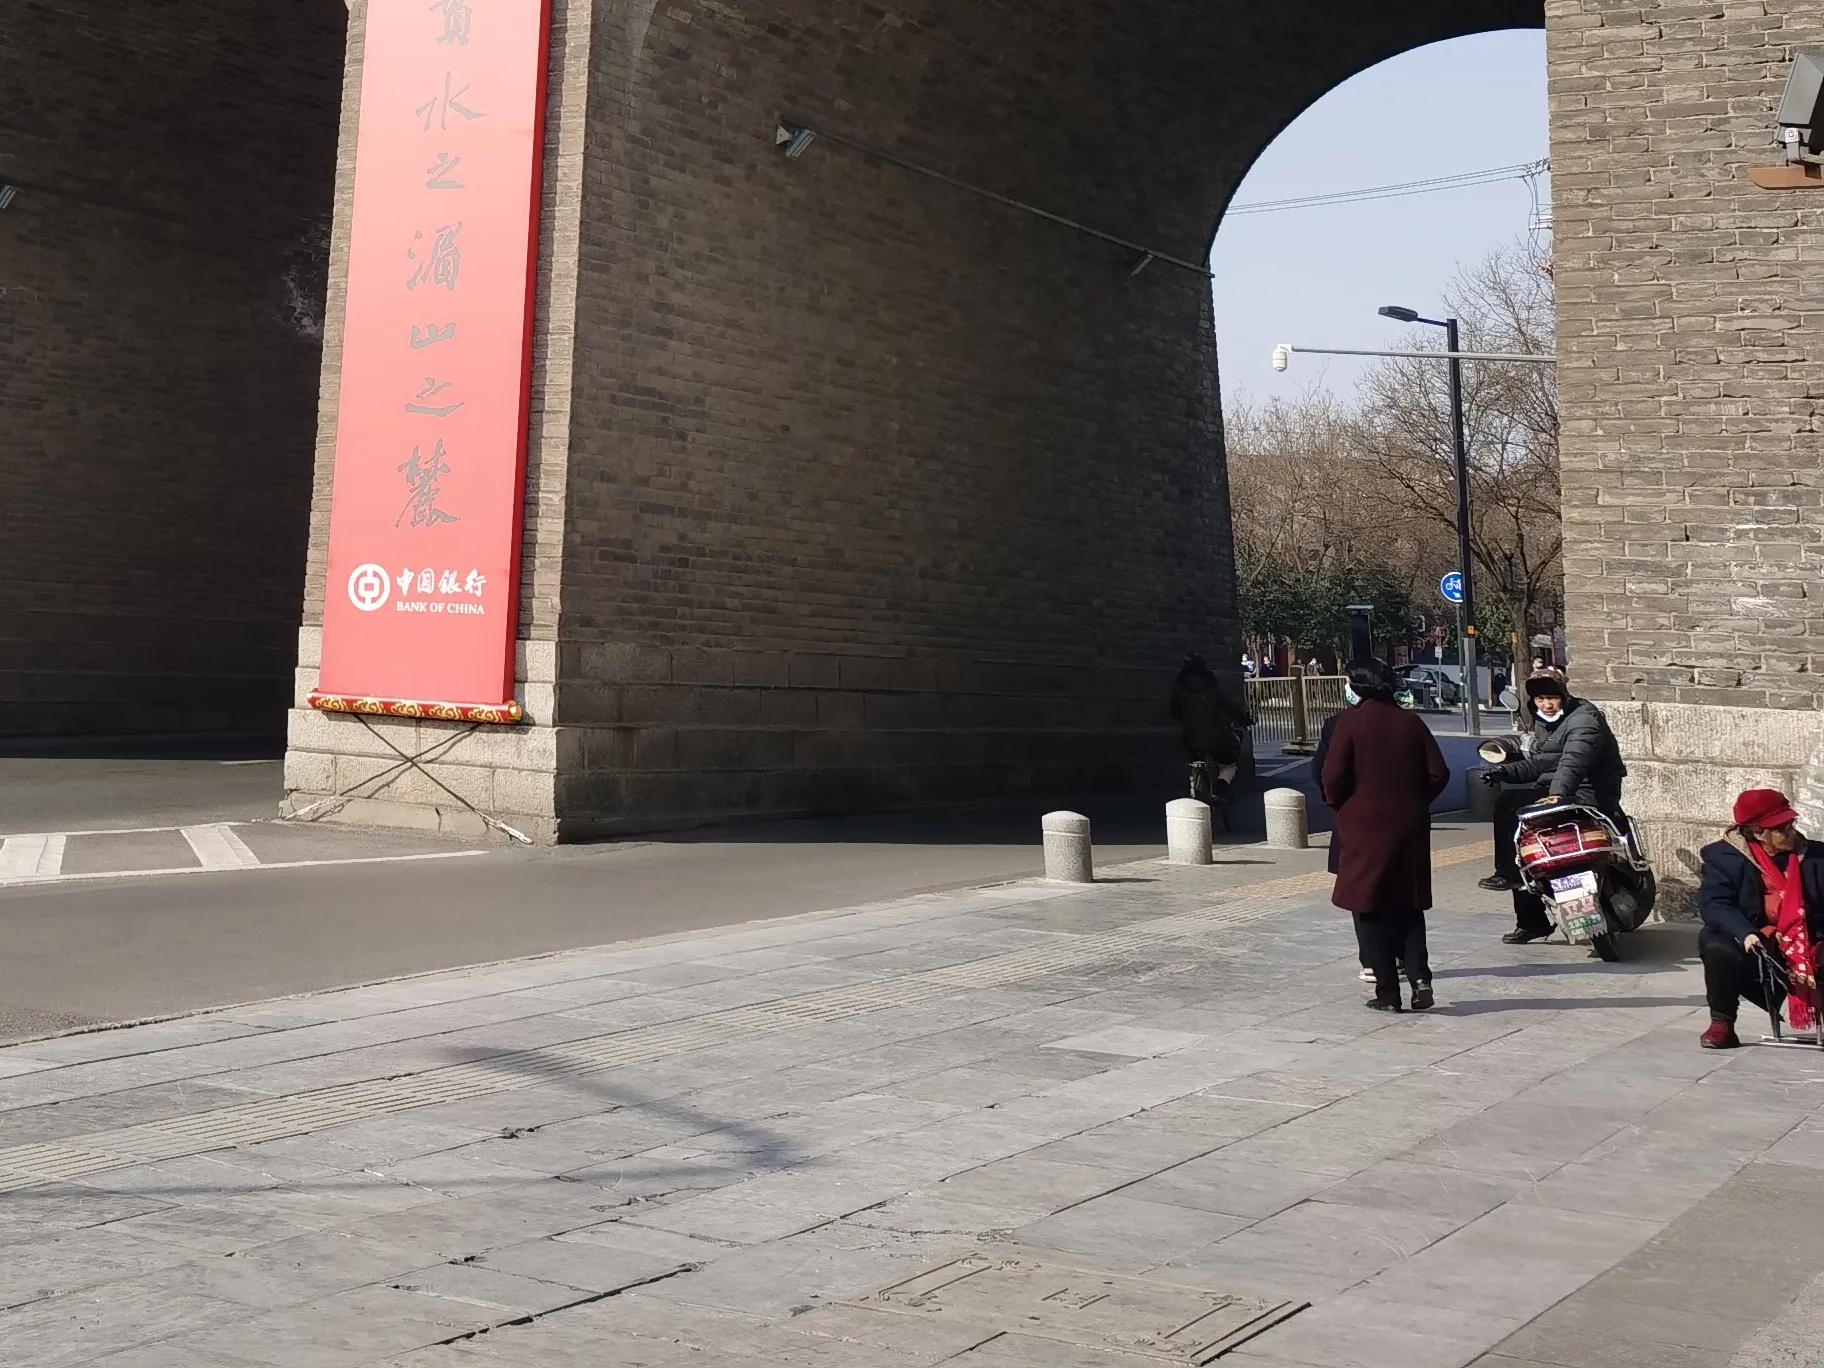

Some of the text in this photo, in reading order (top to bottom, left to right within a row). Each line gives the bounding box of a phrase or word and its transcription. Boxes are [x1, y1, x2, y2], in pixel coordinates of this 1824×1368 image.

[396, 568, 488, 597] 中国银行
[396, 601, 485, 615] BANK OF CHINA
